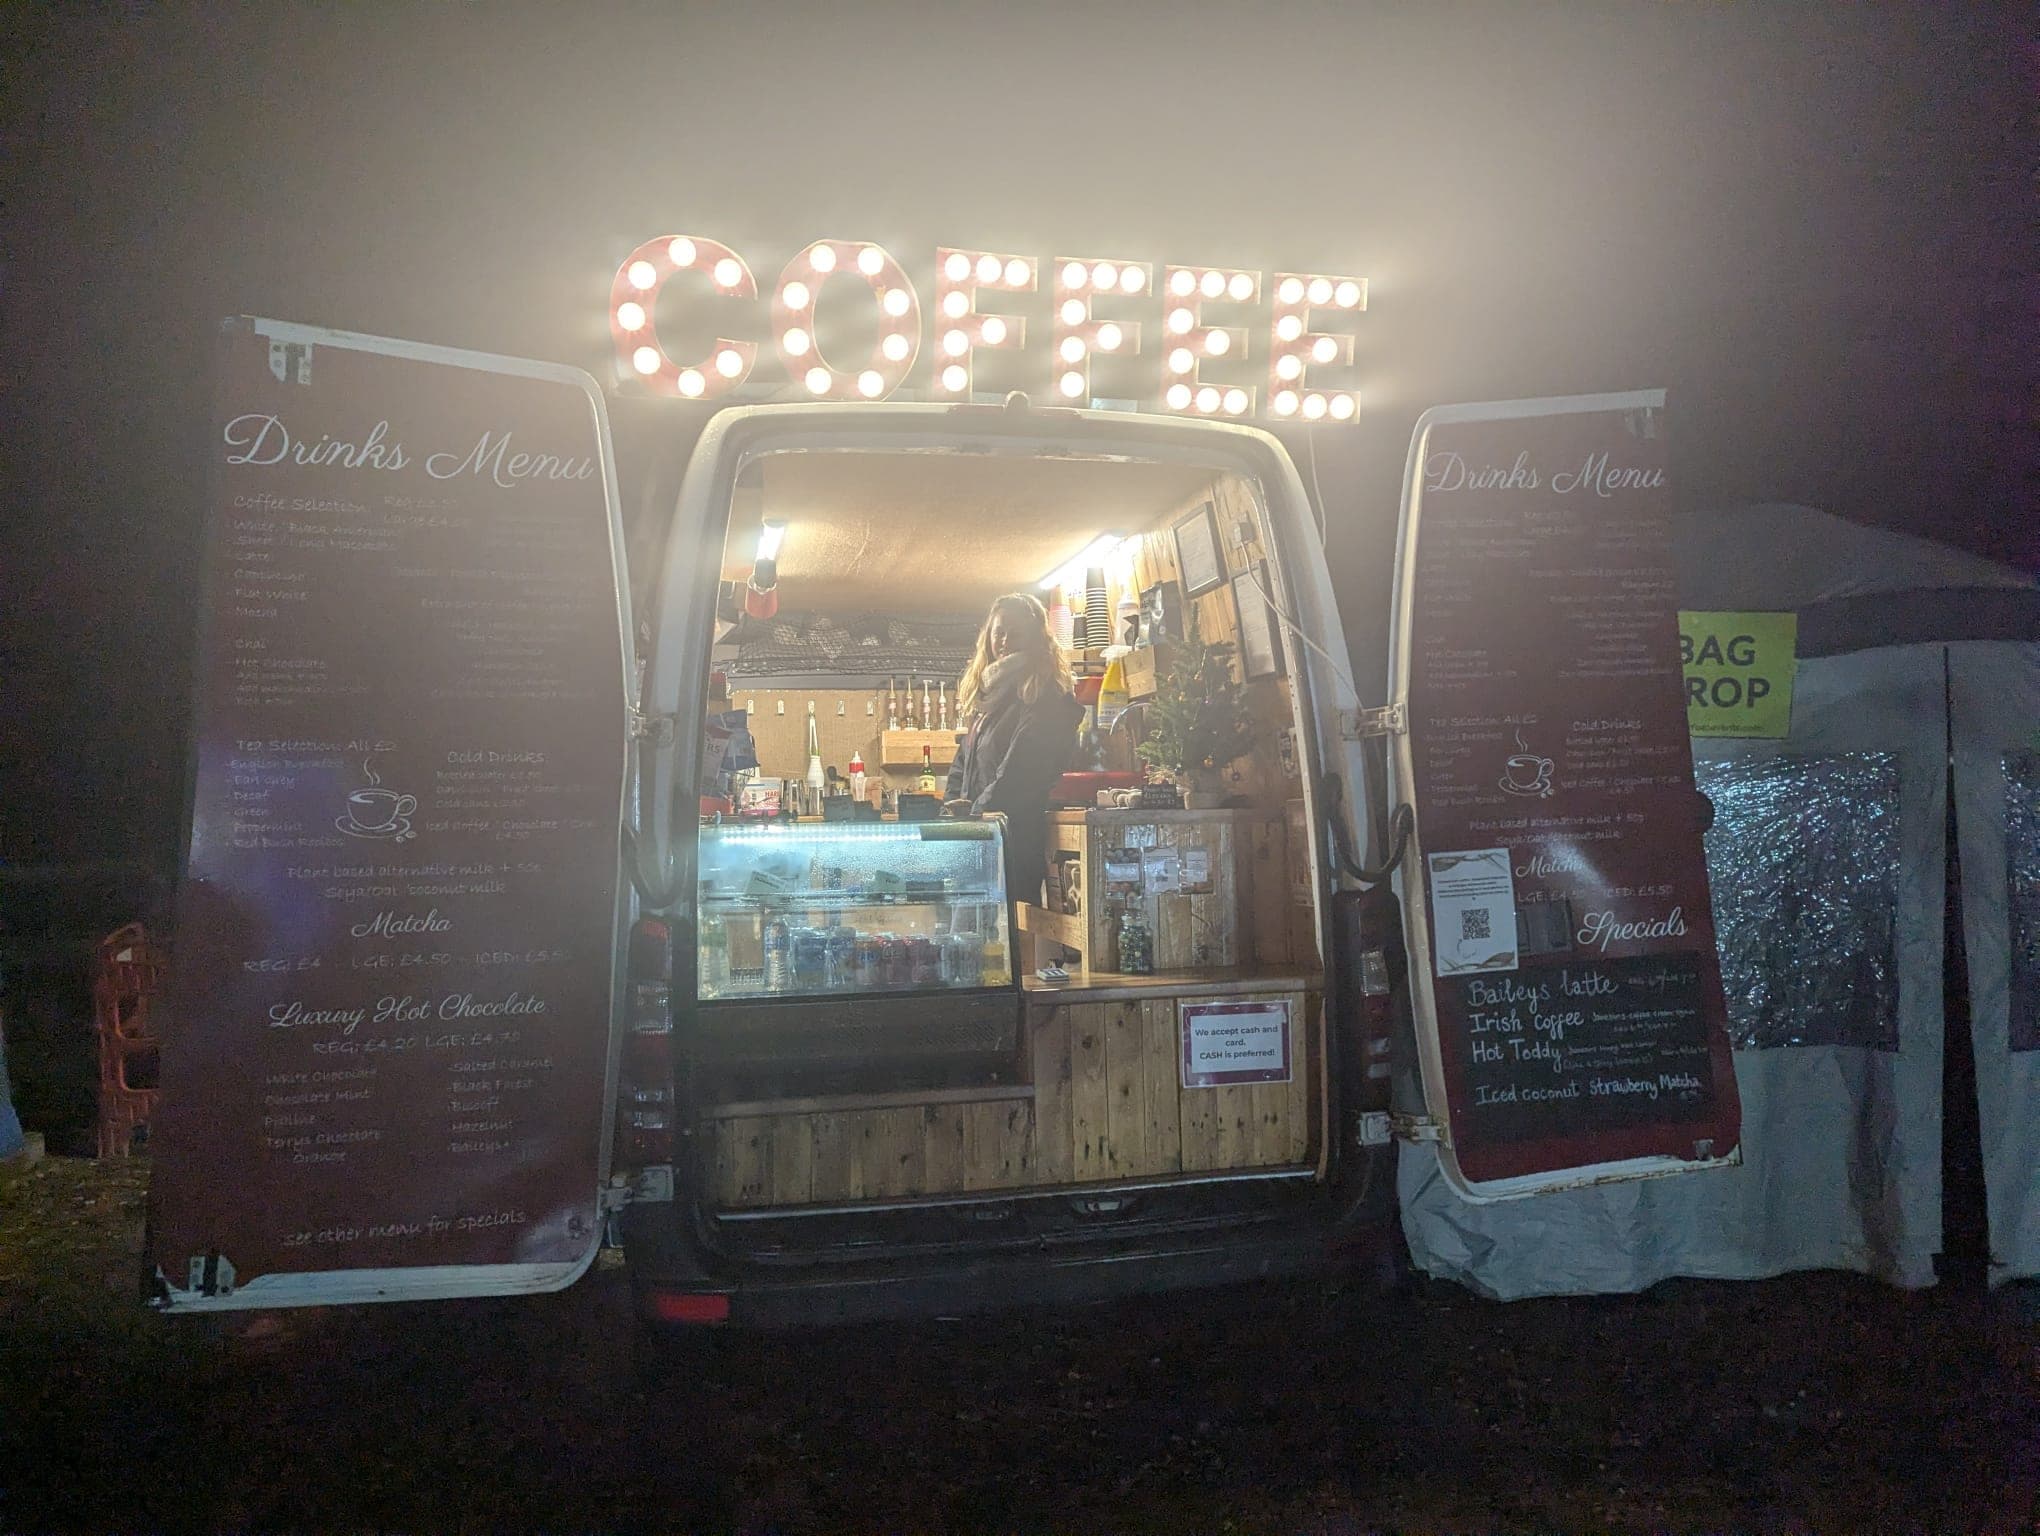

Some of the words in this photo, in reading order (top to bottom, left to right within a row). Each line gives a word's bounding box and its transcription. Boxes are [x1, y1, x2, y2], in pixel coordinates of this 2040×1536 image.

[610, 233, 1369, 424] COFFEE
[223, 413, 411, 470] Drinks
[425, 430, 594, 488] Menu
[1424, 450, 1542, 493] Drinks
[1552, 451, 1665, 497] Menu
[1680, 634, 1756, 666] BAG
[1684, 676, 1770, 708] ROP
[351, 908, 453, 938] Matcha
[1576, 907, 1688, 952] Specials
[1468, 979, 1551, 1014] Baileys
[1560, 970, 1619, 997] latte
[268, 1002, 366, 1035] Luxury
[372, 995, 430, 1024] Hot
[438, 992, 546, 1021] Chocolate
[1469, 1010, 1523, 1033] Irish
[1211, 1028, 1238, 1036] accept
[1233, 1050, 1275, 1059] preferred!
[1472, 1040, 1505, 1063] Hot
[1508, 1038, 1562, 1073] Toddy
[1475, 1083, 1518, 1105] Iced
[1659, 1071, 1701, 1090] Matcha
[317, 1226, 364, 1244] other
[427, 1214, 452, 1238] for
[458, 1210, 527, 1233] specials
